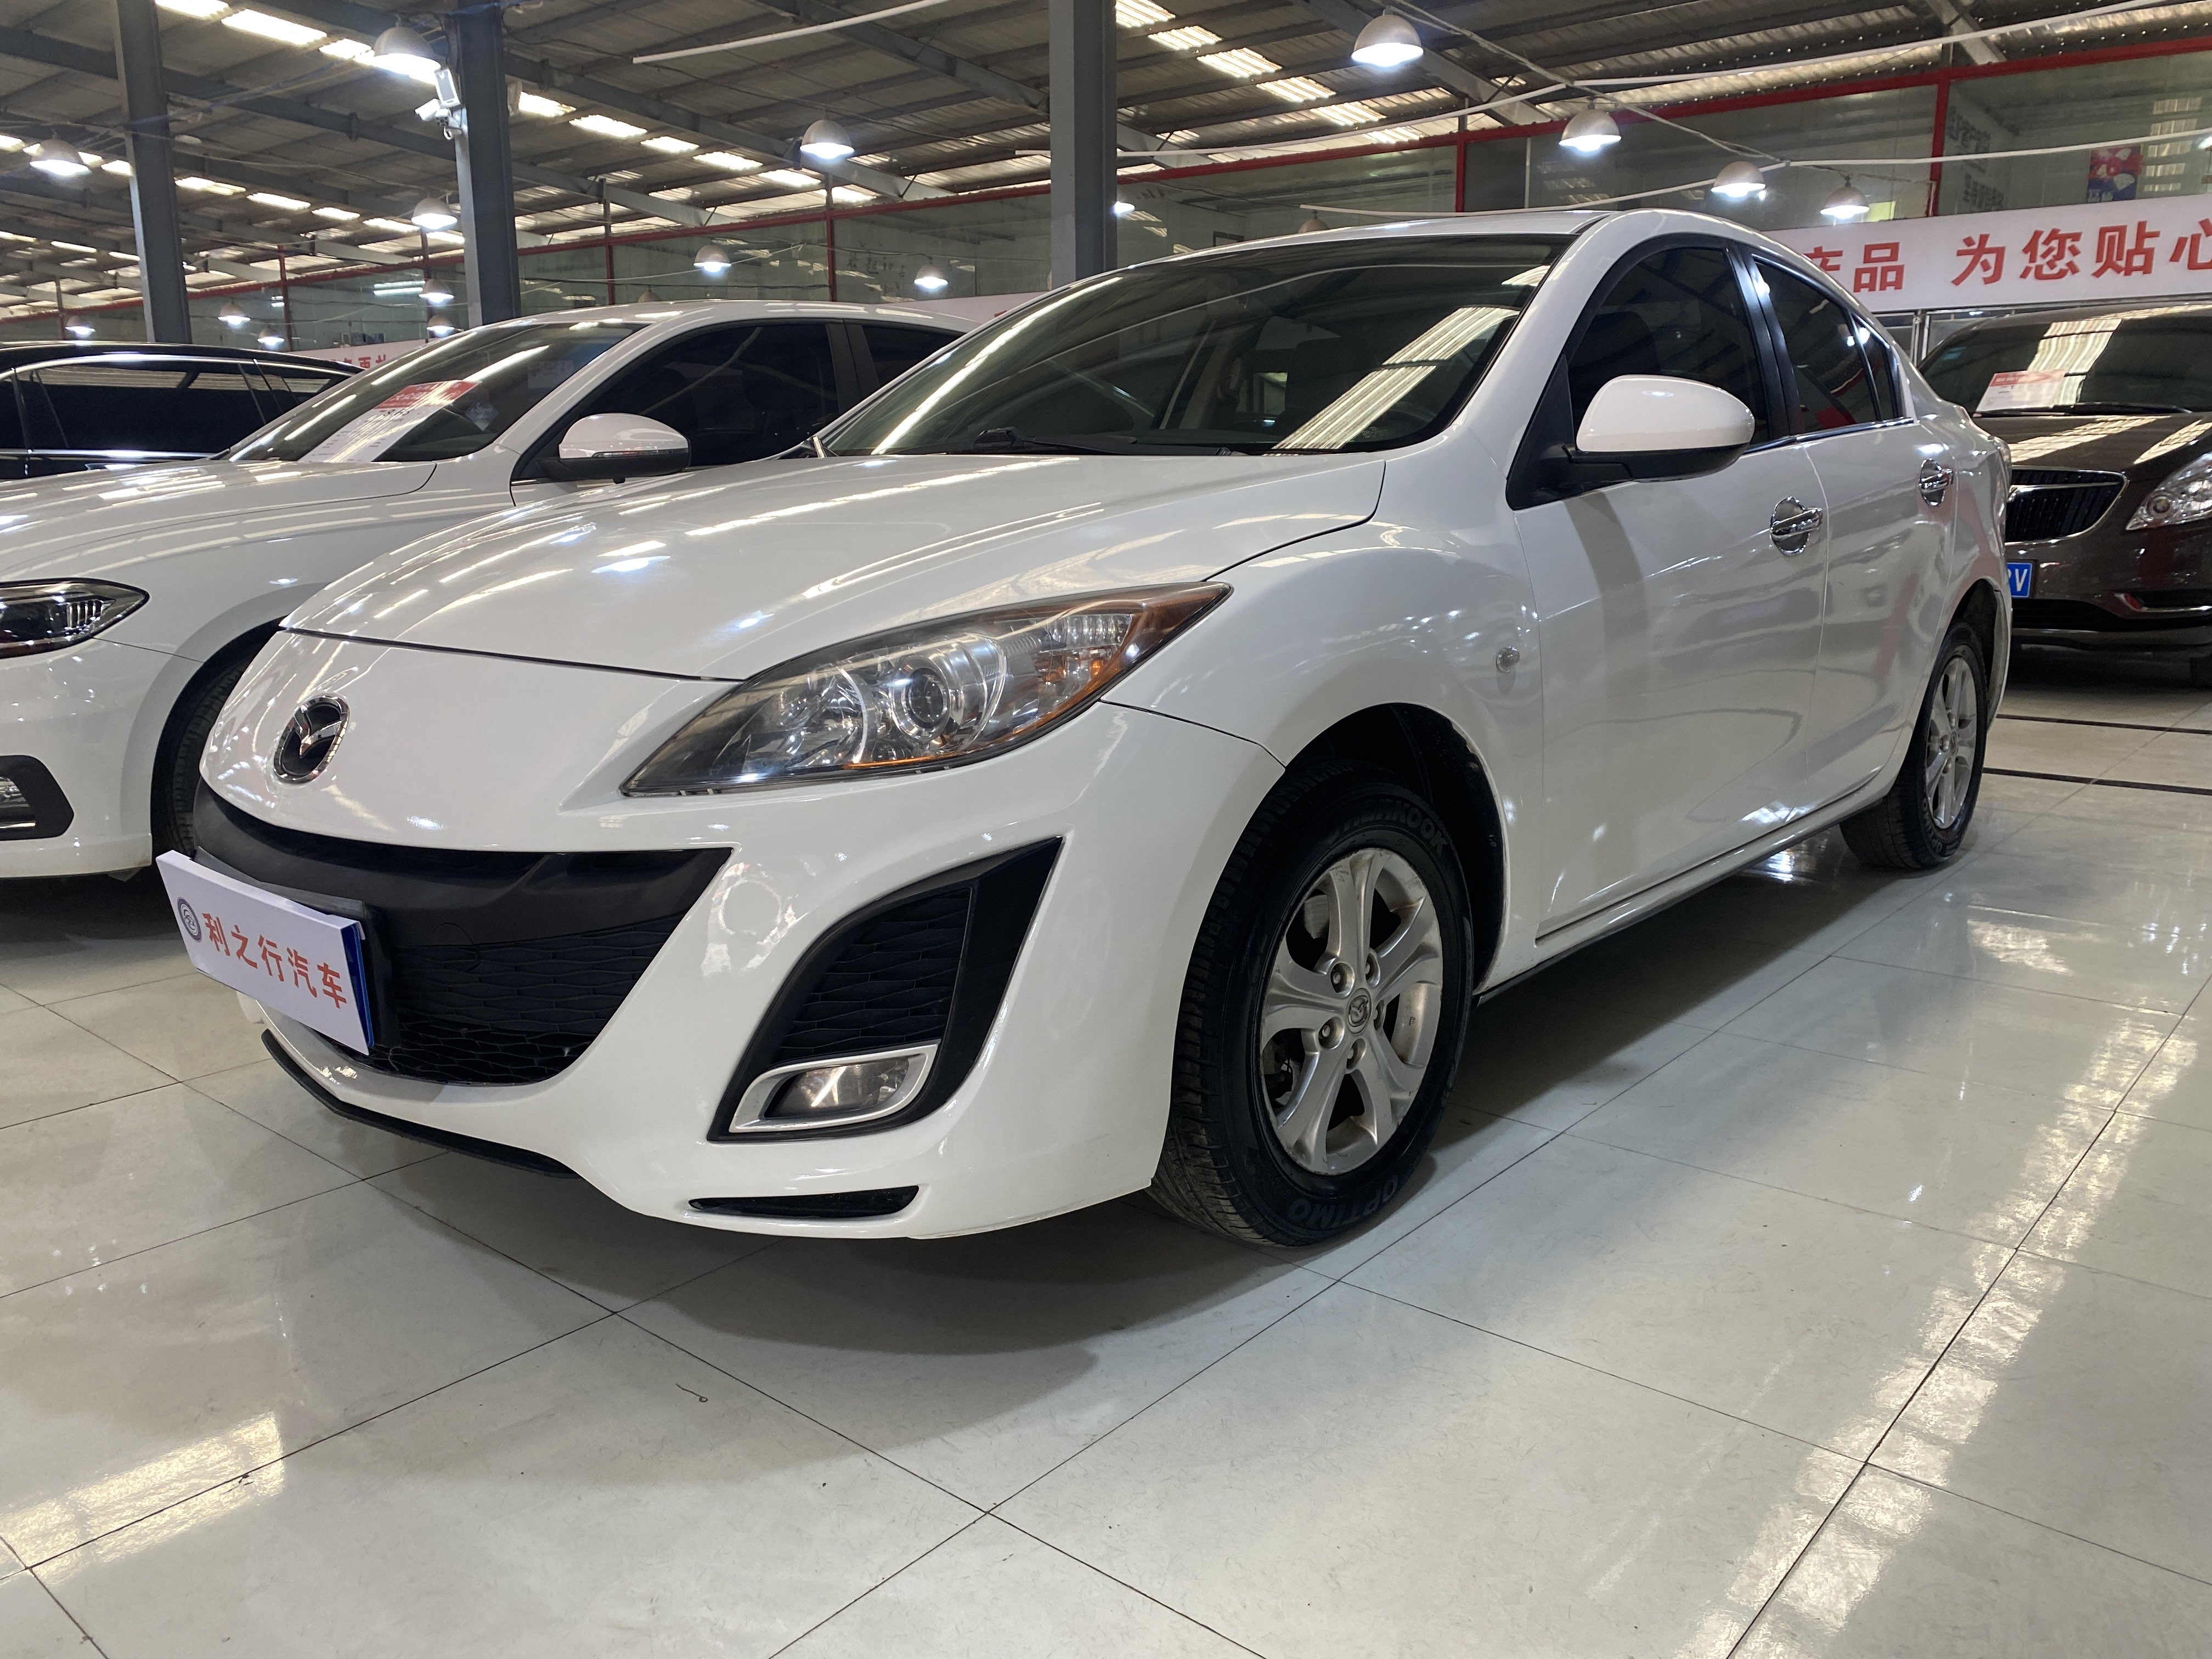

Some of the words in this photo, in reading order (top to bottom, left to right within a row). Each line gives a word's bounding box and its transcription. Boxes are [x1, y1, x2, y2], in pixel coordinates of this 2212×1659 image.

[202, 913, 347, 1008] 利之行汽车
